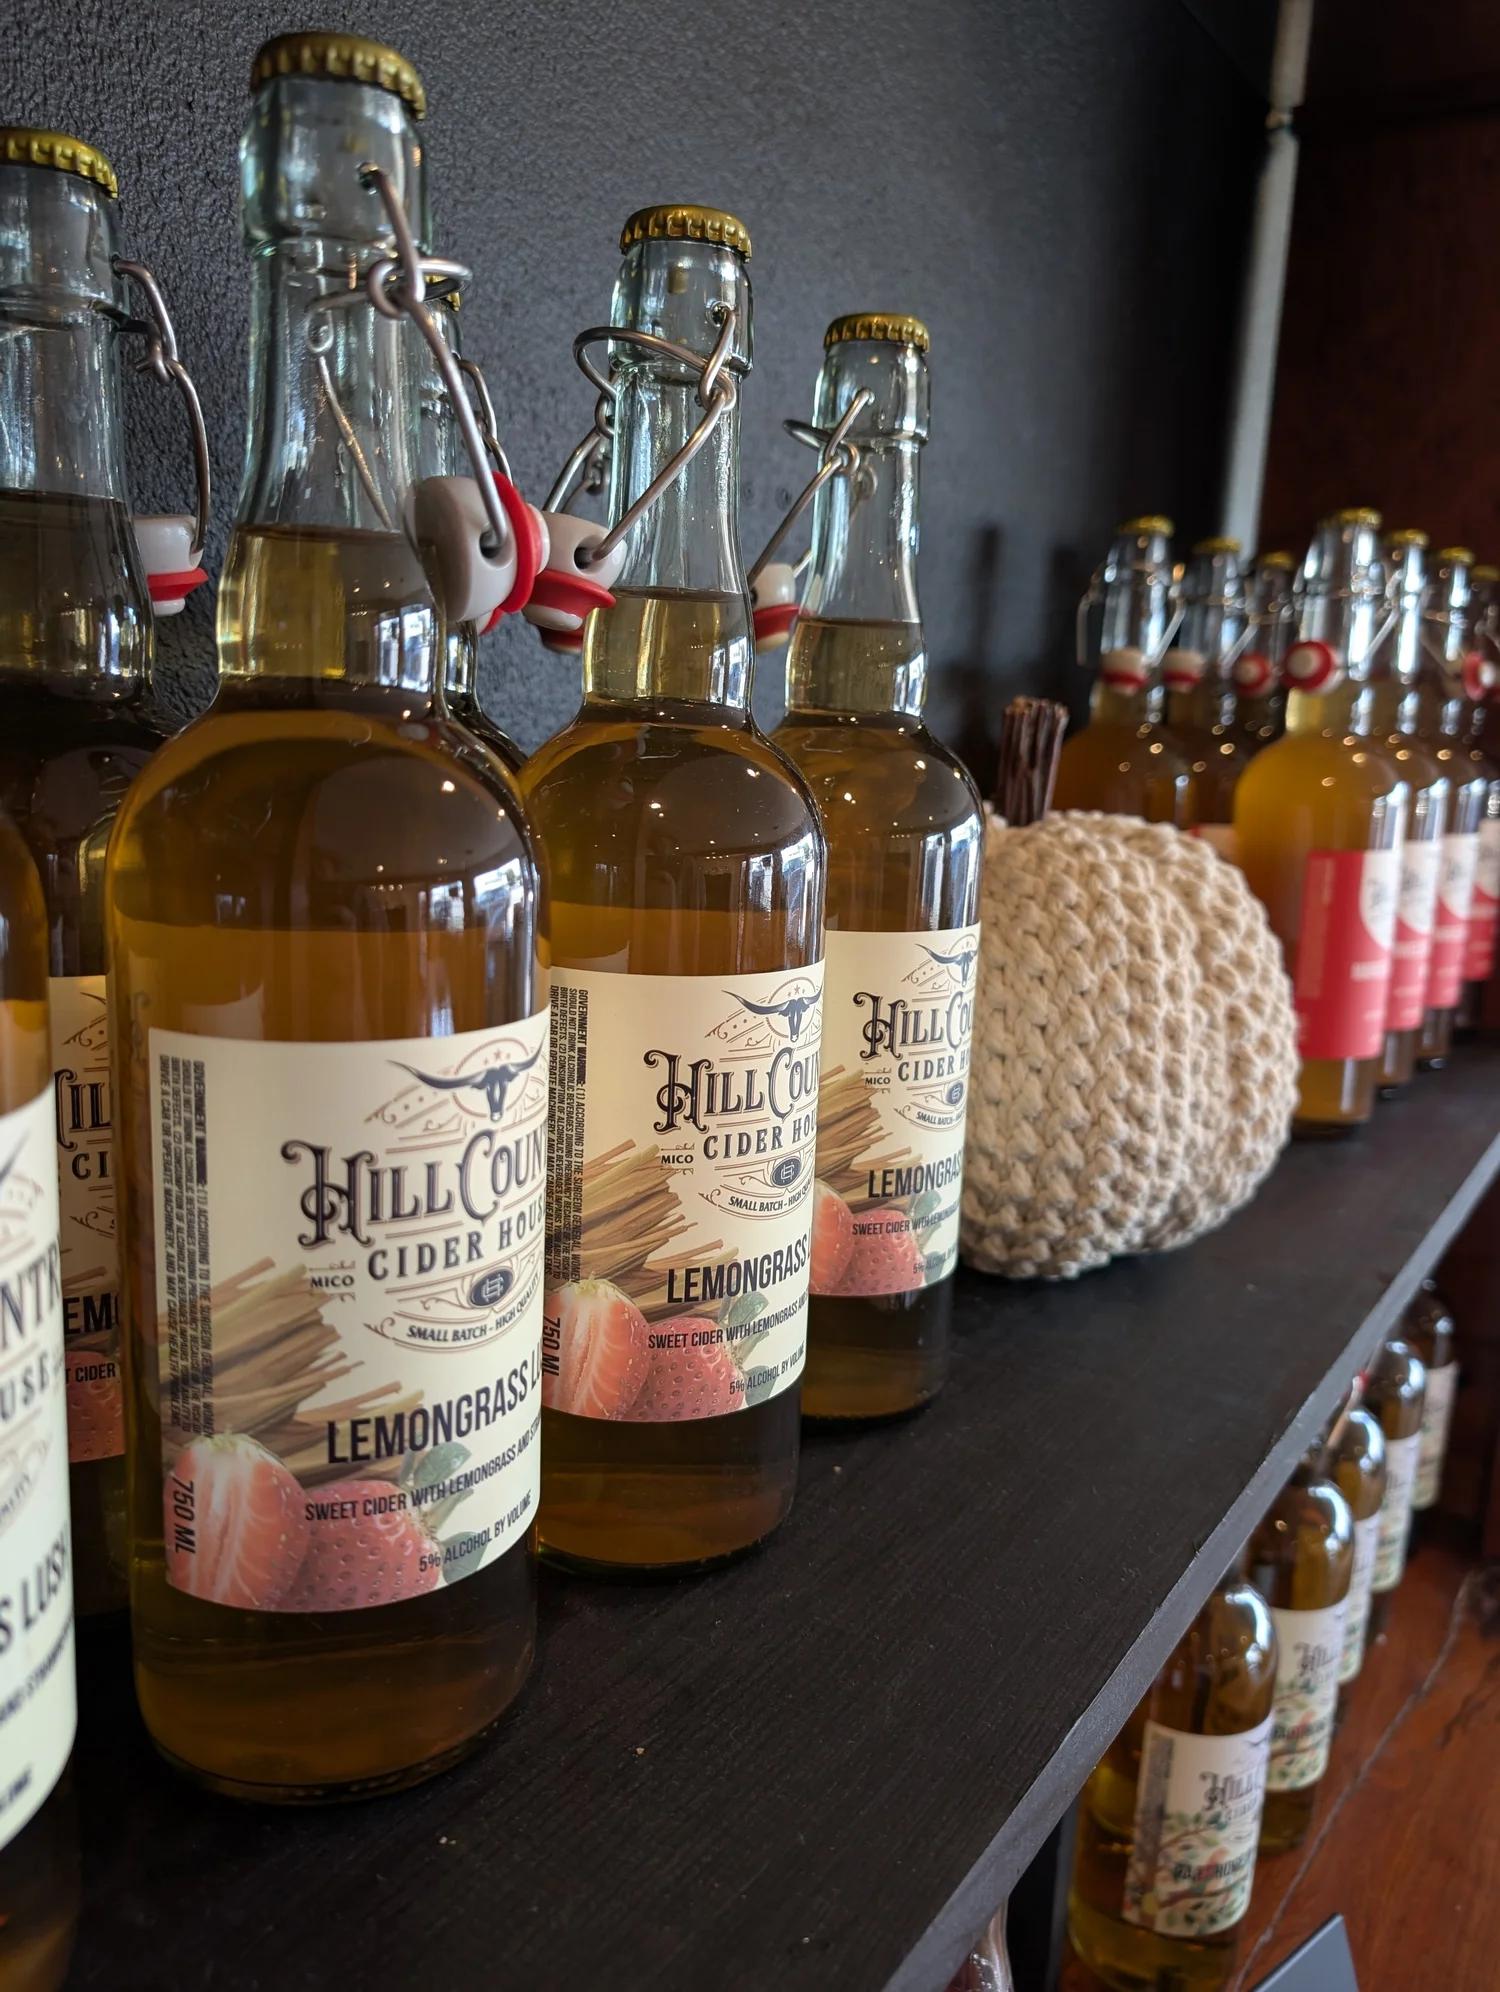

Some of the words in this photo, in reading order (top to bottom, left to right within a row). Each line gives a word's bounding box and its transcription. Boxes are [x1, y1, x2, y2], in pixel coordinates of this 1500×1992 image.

[550, 985, 559, 1010] DRIVE
[560, 987, 568, 1008] BIRTH
[568, 988, 578, 1016] SHOULD
[550, 1019, 558, 1035] CAR
[568, 1016, 577, 1031] NOT
[578, 990, 588, 1045] GOVERNMENT
[853, 991, 944, 1060] HILL
[550, 1037, 558, 1048] OR
[568, 1032, 577, 1053] DRINK
[549, 1050, 558, 1085] OPERATE
[567, 1054, 576, 1092] ALCOHOLIC
[865, 1077, 891, 1085] MICO
[898, 1055, 954, 1081] CIDER
[643, 1049, 765, 1135] HILL
[557, 1105, 565, 1115] OF
[566, 1093, 575, 1132] BEVERAGES
[575, 1101, 585, 1146] ACCORDING
[916, 1111, 937, 1124] SMALL
[547, 1137, 556, 1154] AND
[556, 1115, 565, 1153] ALCOHOLIC
[565, 1133, 574, 1158] DURING
[703, 1125, 783, 1161] CIDER
[792, 1108, 817, 1144] HOU
[574, 1148, 584, 1158] TO
[574, 1160, 584, 1175] THE
[661, 1154, 694, 1164] MICO
[281, 1139, 453, 1249] HILL
[456, 1120, 546, 1223] COUN
[868, 1149, 962, 1198] LEMONGRAS
[573, 1176, 583, 1213] SURGEON
[728, 1196, 758, 1212] SMALL
[759, 1200, 783, 1212] BATCH
[368, 1230, 485, 1281] CIDER
[497, 1191, 544, 1251] HOUS
[852, 1222, 883, 1236] SWEET
[886, 1220, 910, 1234] CIDER
[310, 1274, 355, 1289] MICO
[571, 1253, 581, 1284] WOMEN
[667, 1233, 807, 1303] LEMONGRASS
[407, 1324, 449, 1343] SMALL
[452, 1323, 487, 1342] BATCH
[495, 1306, 516, 1330] HIGH
[543, 1316, 560, 1351] 750
[648, 1333, 688, 1349] SWEET
[691, 1329, 723, 1347] CIDER
[726, 1324, 750, 1342] WITH
[751, 1300, 798, 1335] LEMONGRASS
[75, 1363, 116, 1383] CIDER
[542, 1352, 560, 1376] ML
[729, 1380, 745, 1395] 5%
[747, 1368, 780, 1392] ALCOHOL
[781, 1357, 789, 1375] BY
[327, 1359, 528, 1465] LEMONGRASS
[306, 1500, 358, 1521] SWEET
[363, 1493, 407, 1516] CIDER
[411, 1483, 446, 1507] WITH
[449, 1444, 516, 1496] LEMONGRASS
[172, 1476, 195, 1521] 750
[175, 1523, 196, 1554] ML
[419, 1552, 441, 1572] 5%
[443, 1526, 492, 1563] ALCOHOL
[494, 1517, 505, 1536] BY
[507, 1489, 532, 1528] VOLUME
